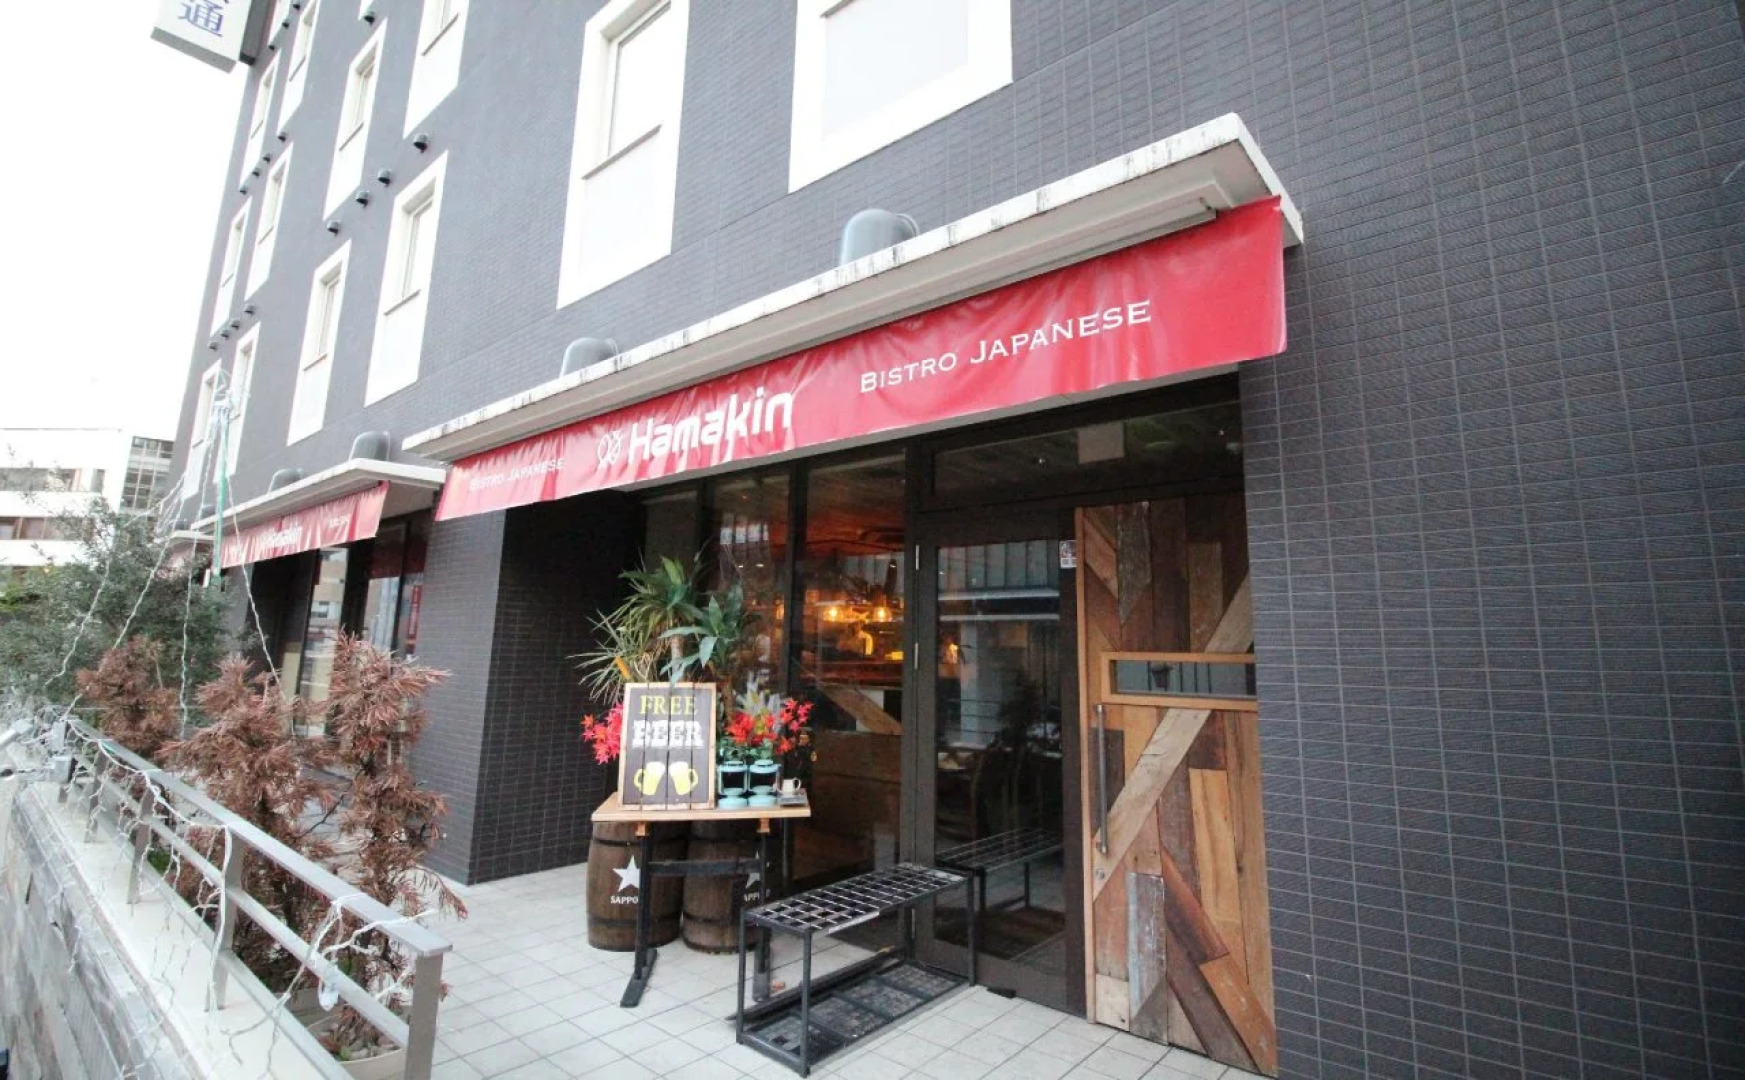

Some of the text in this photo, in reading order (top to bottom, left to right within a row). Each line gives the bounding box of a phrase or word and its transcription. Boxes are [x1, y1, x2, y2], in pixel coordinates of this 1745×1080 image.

[178, 0, 229, 37] 通
[861, 300, 1151, 393] BISTRO JAPANESE
[628, 386, 793, 464] Hamakin
[508, 458, 565, 481] JAPANESE
[639, 695, 699, 716] FREE
[632, 719, 704, 749] BEER
[610, 895, 639, 904] SAPPO
